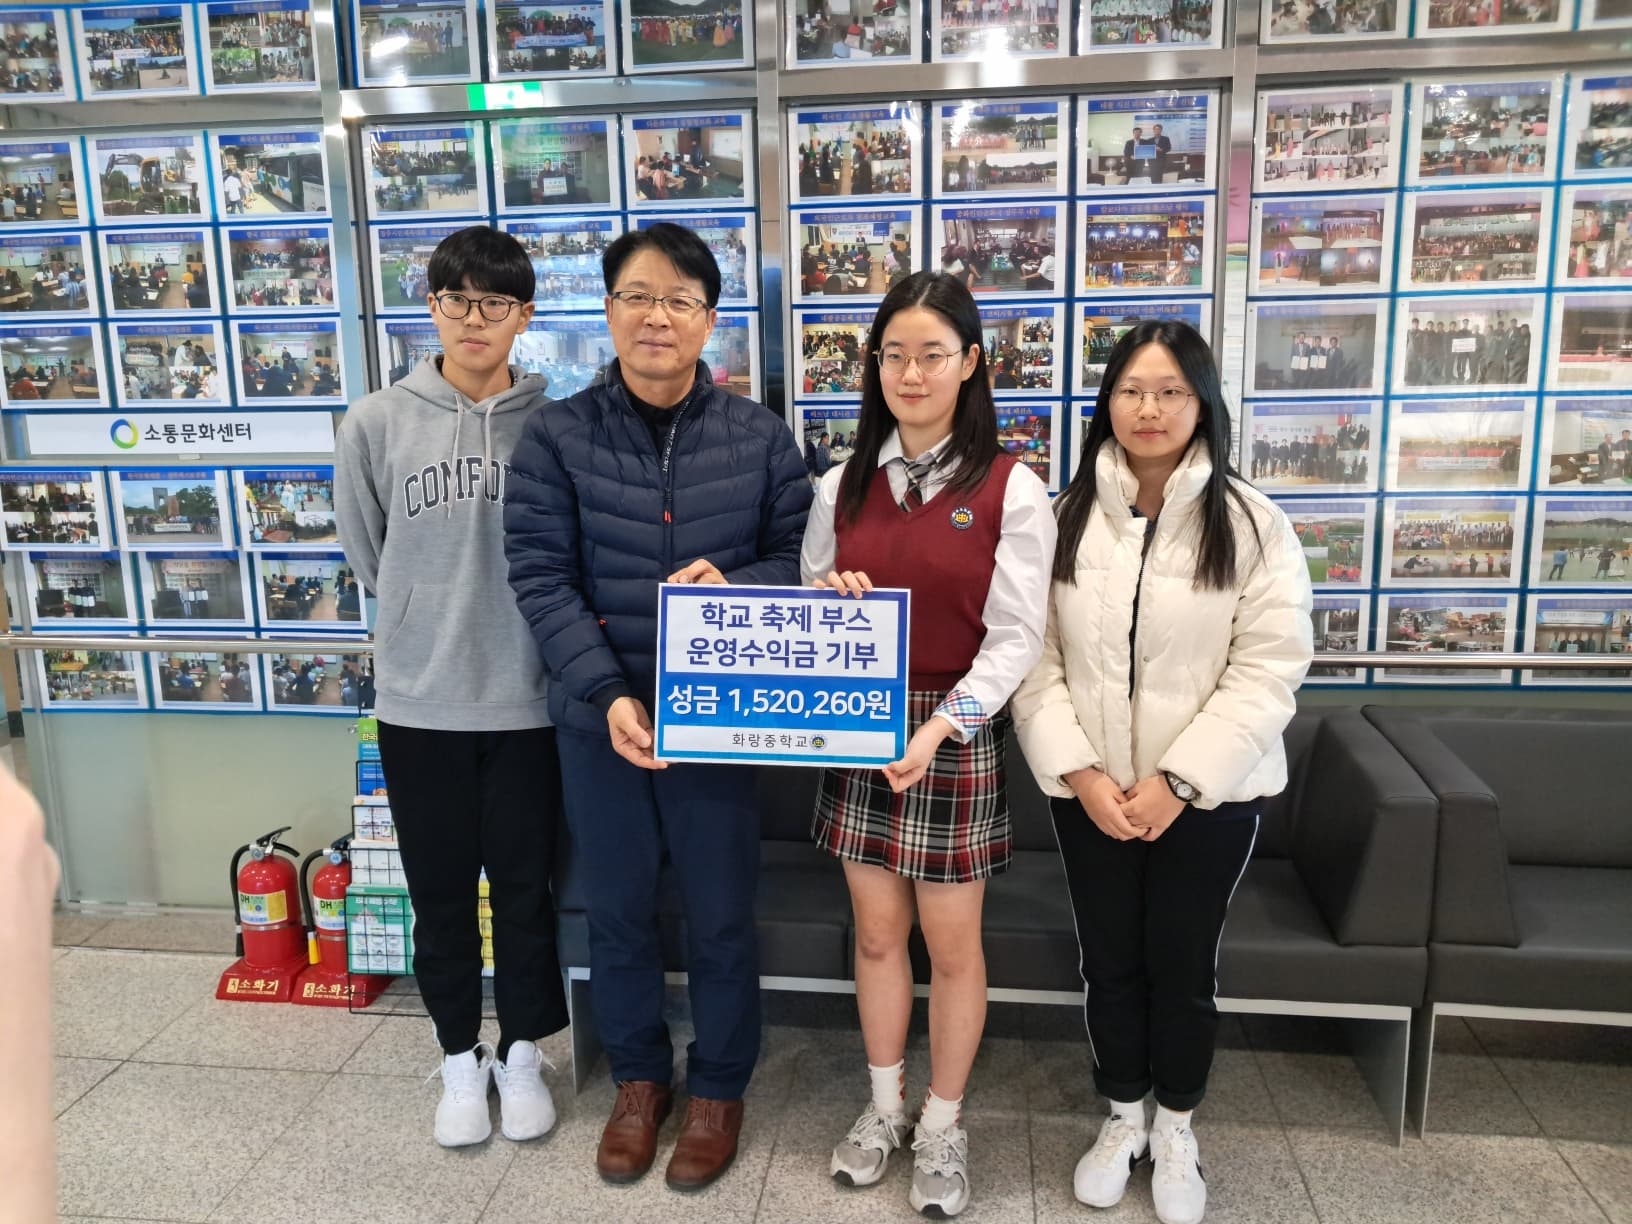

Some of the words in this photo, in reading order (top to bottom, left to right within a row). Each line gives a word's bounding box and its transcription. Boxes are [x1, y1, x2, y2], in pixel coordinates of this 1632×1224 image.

[144, 422, 252, 444] 소통문화센터
[700, 602, 753, 632] 학교
[759, 603, 812, 633] 축제
[818, 605, 873, 634] 부스
[686, 637, 819, 669] 운영수익금
[826, 641, 879, 670] 기부
[667, 684, 721, 715] 성금
[727, 688, 892, 720] 1,520,260원
[732, 732, 808, 749] 화랑중학교
[320, 899, 333, 910] DH
[238, 979, 279, 991] 소화기
[314, 983, 356, 997] 소화기
